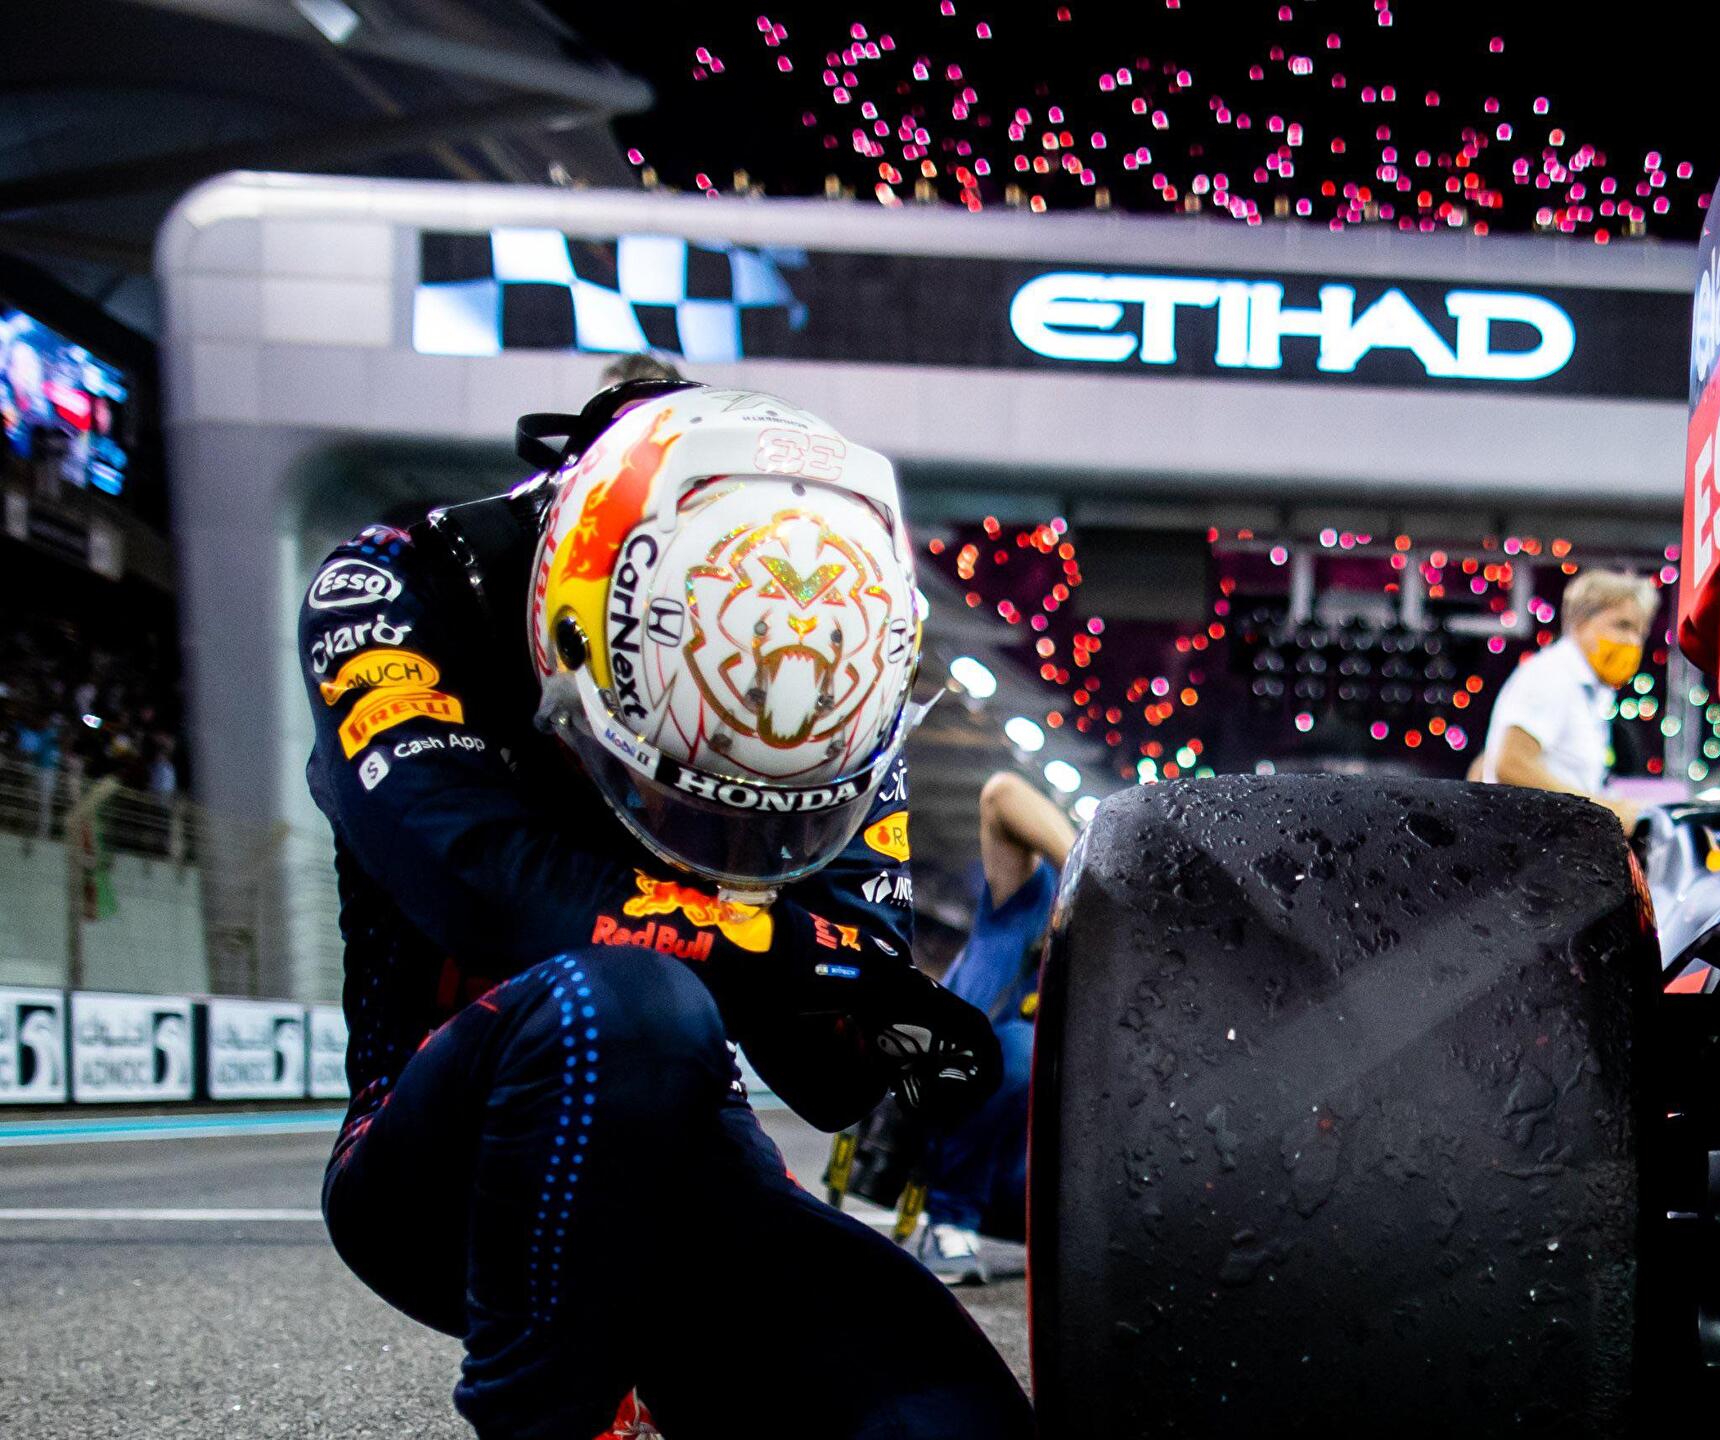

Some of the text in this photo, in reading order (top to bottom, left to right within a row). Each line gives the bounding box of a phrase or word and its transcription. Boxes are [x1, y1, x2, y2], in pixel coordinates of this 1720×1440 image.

[1009, 272, 1577, 382] ETIHAD
[610, 533, 658, 720] CarNext
[393, 733, 486, 758] Cash App
[674, 767, 858, 813] HONDA
[592, 915, 714, 962] Red Bull
